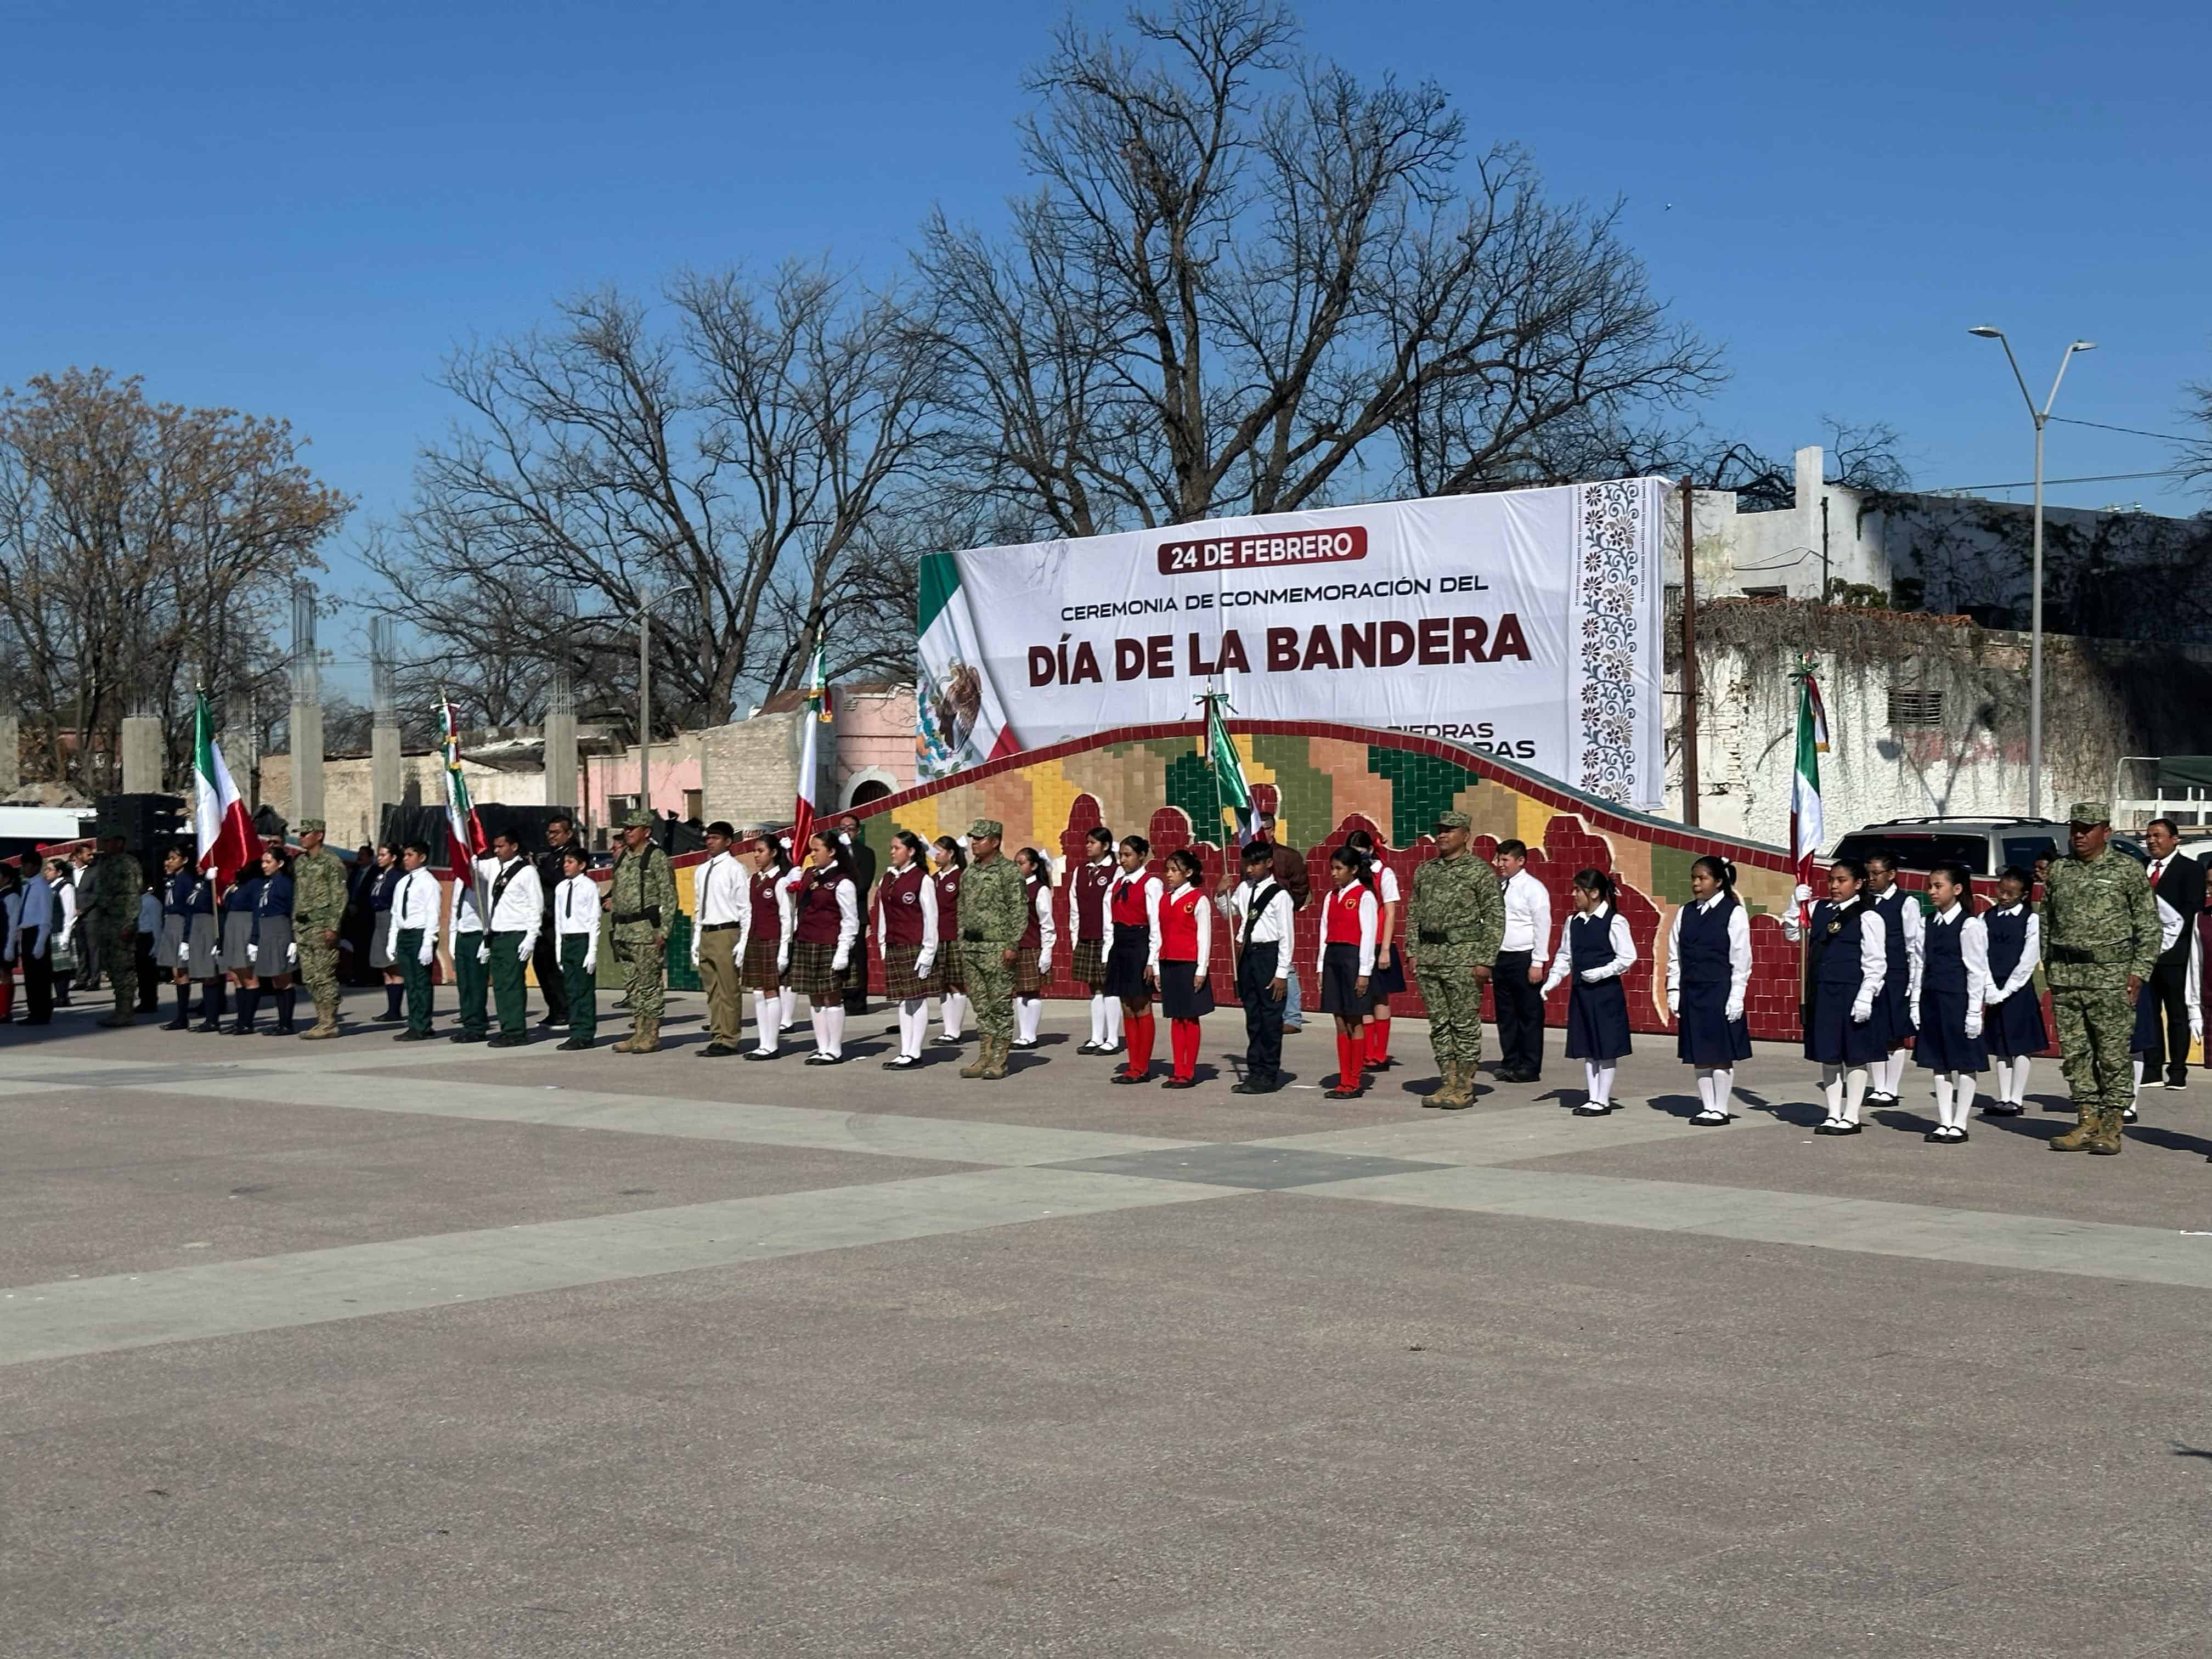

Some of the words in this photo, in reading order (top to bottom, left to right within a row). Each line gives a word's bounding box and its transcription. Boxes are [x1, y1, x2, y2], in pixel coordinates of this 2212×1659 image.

[1171, 545, 1198, 569] 24
[1204, 542, 1234, 567] DE
[1240, 532, 1353, 563] FEBRERO
[1060, 596, 1178, 622] CEREMONIA
[1185, 593, 1214, 610] DE
[1219, 575, 1431, 607] CONMEMORACIÓN
[1440, 575, 1489, 593] DEL
[1028, 633, 1103, 687] DÍA
[1115, 634, 1174, 681] DE
[1189, 629, 1251, 676] LA
[1267, 613, 1532, 672] BANDERA
[1386, 723, 1494, 738] EDRAS
